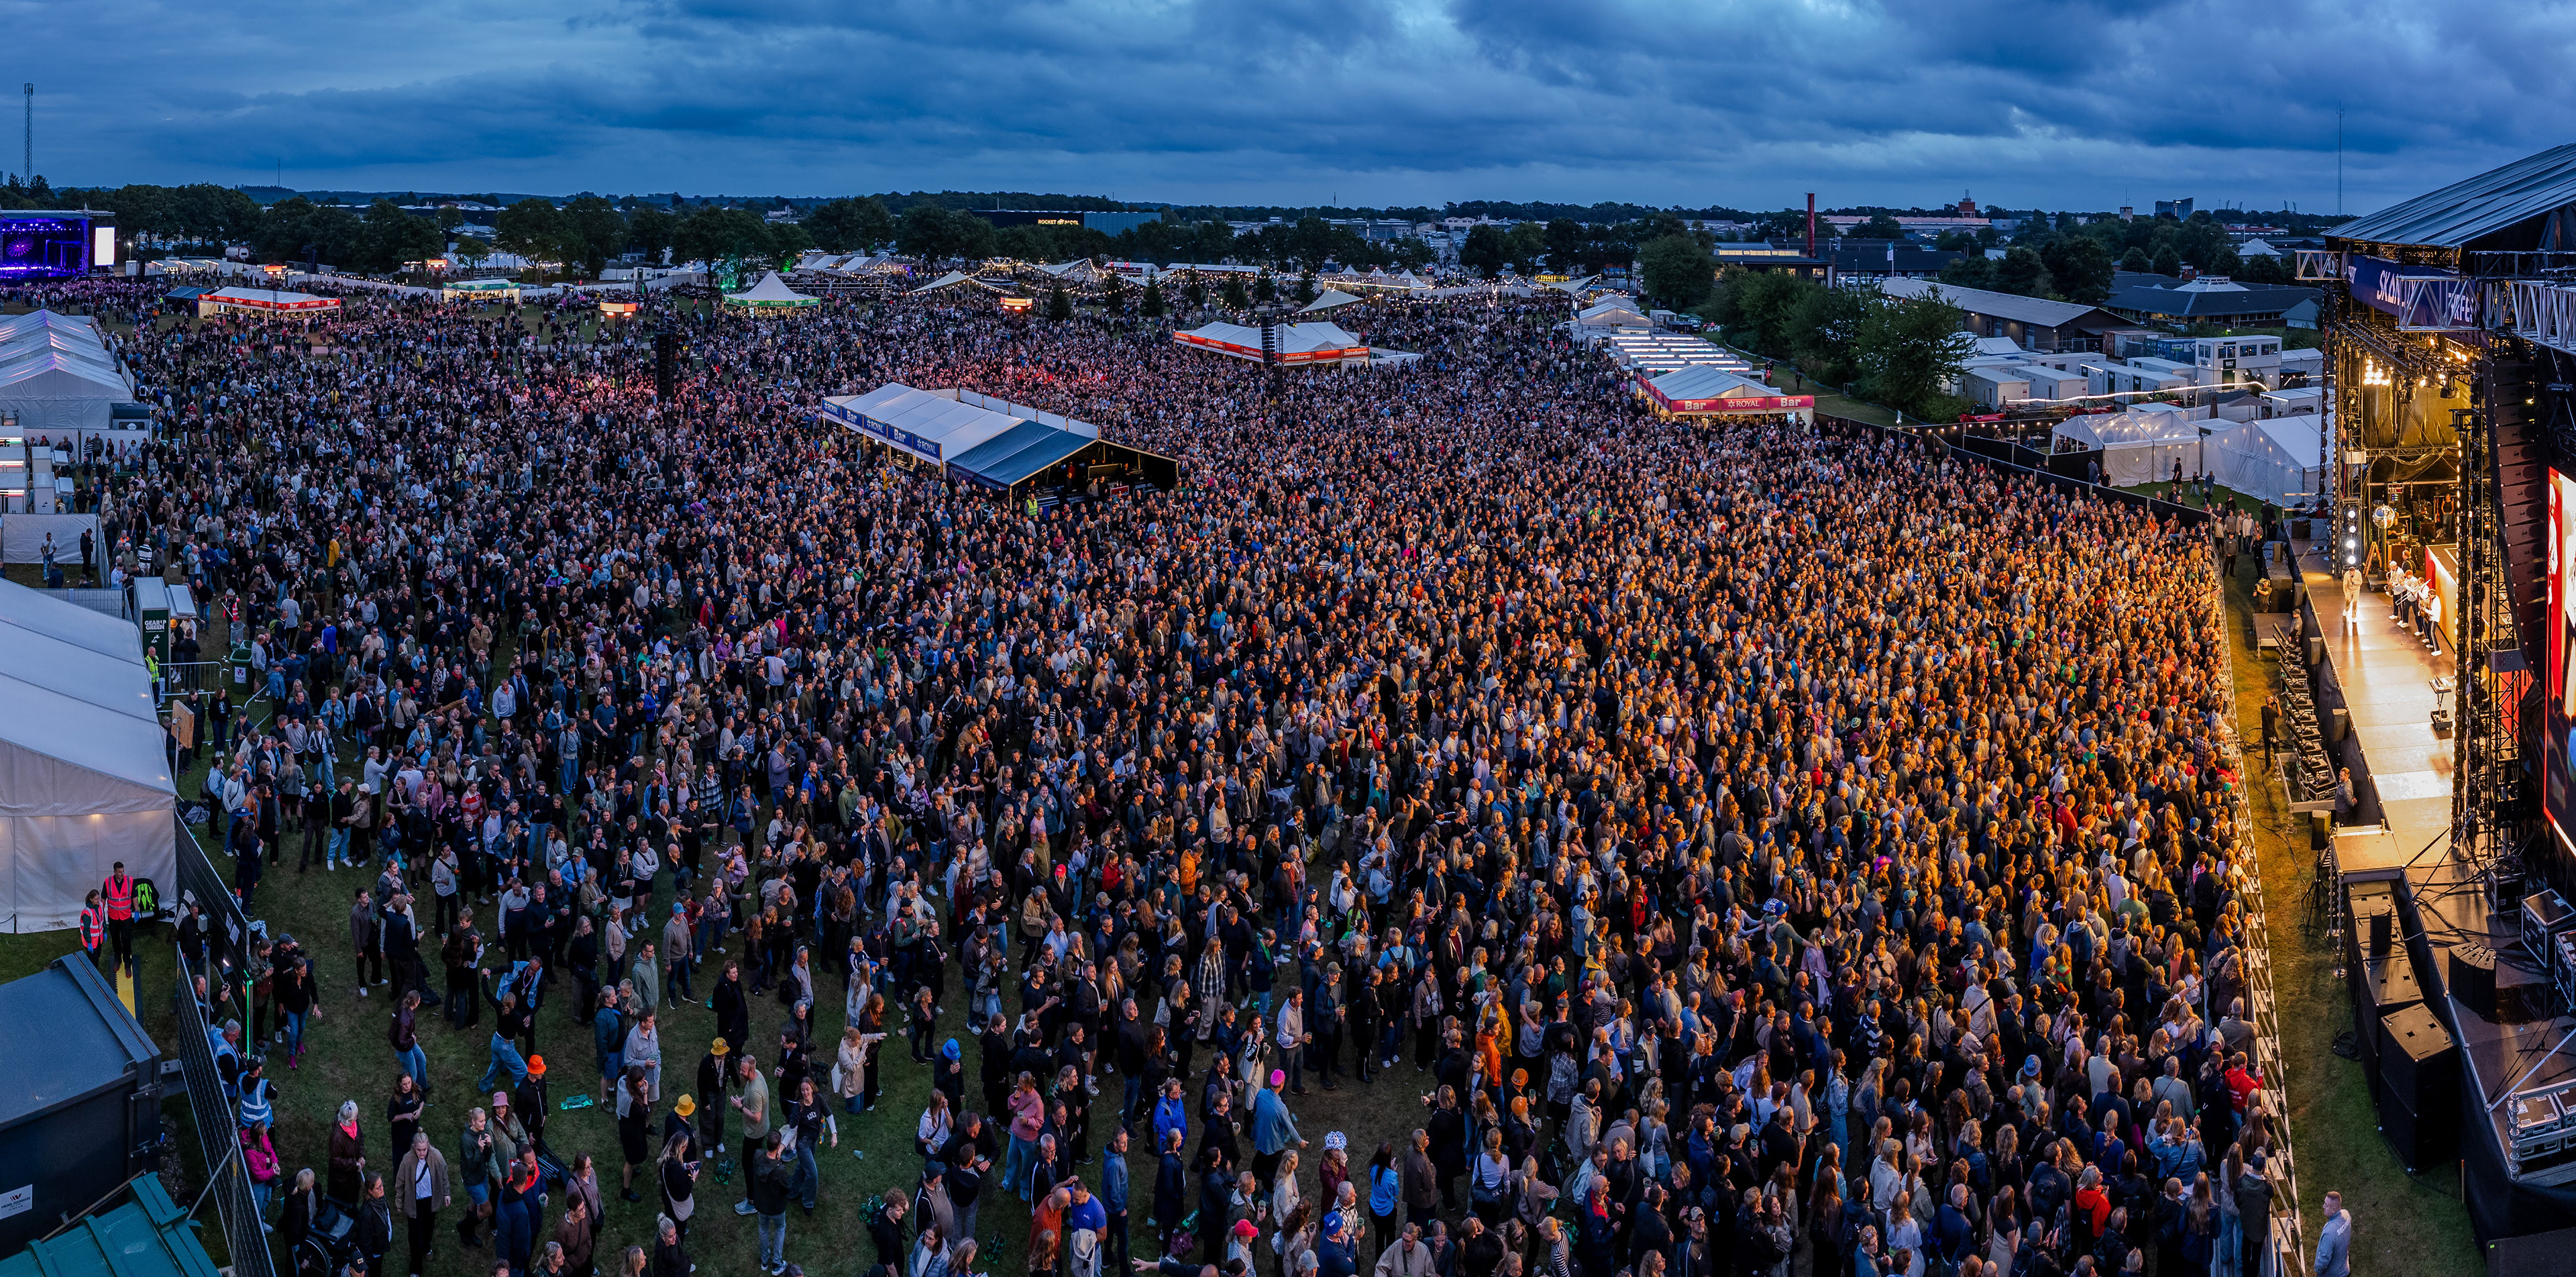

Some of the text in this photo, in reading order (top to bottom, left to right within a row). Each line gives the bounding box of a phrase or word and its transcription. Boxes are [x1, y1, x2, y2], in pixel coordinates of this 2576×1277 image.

[1684, 401, 1707, 411] Bar
[1736, 399, 1760, 407] ROYAL
[1780, 397, 1801, 407] Bar
[827, 403, 839, 415] ROYAL
[847, 410, 857, 422] Bar
[871, 421, 883, 433] ROYAL
[894, 428, 906, 442] Bar
[921, 441, 936, 454] ROYAL
